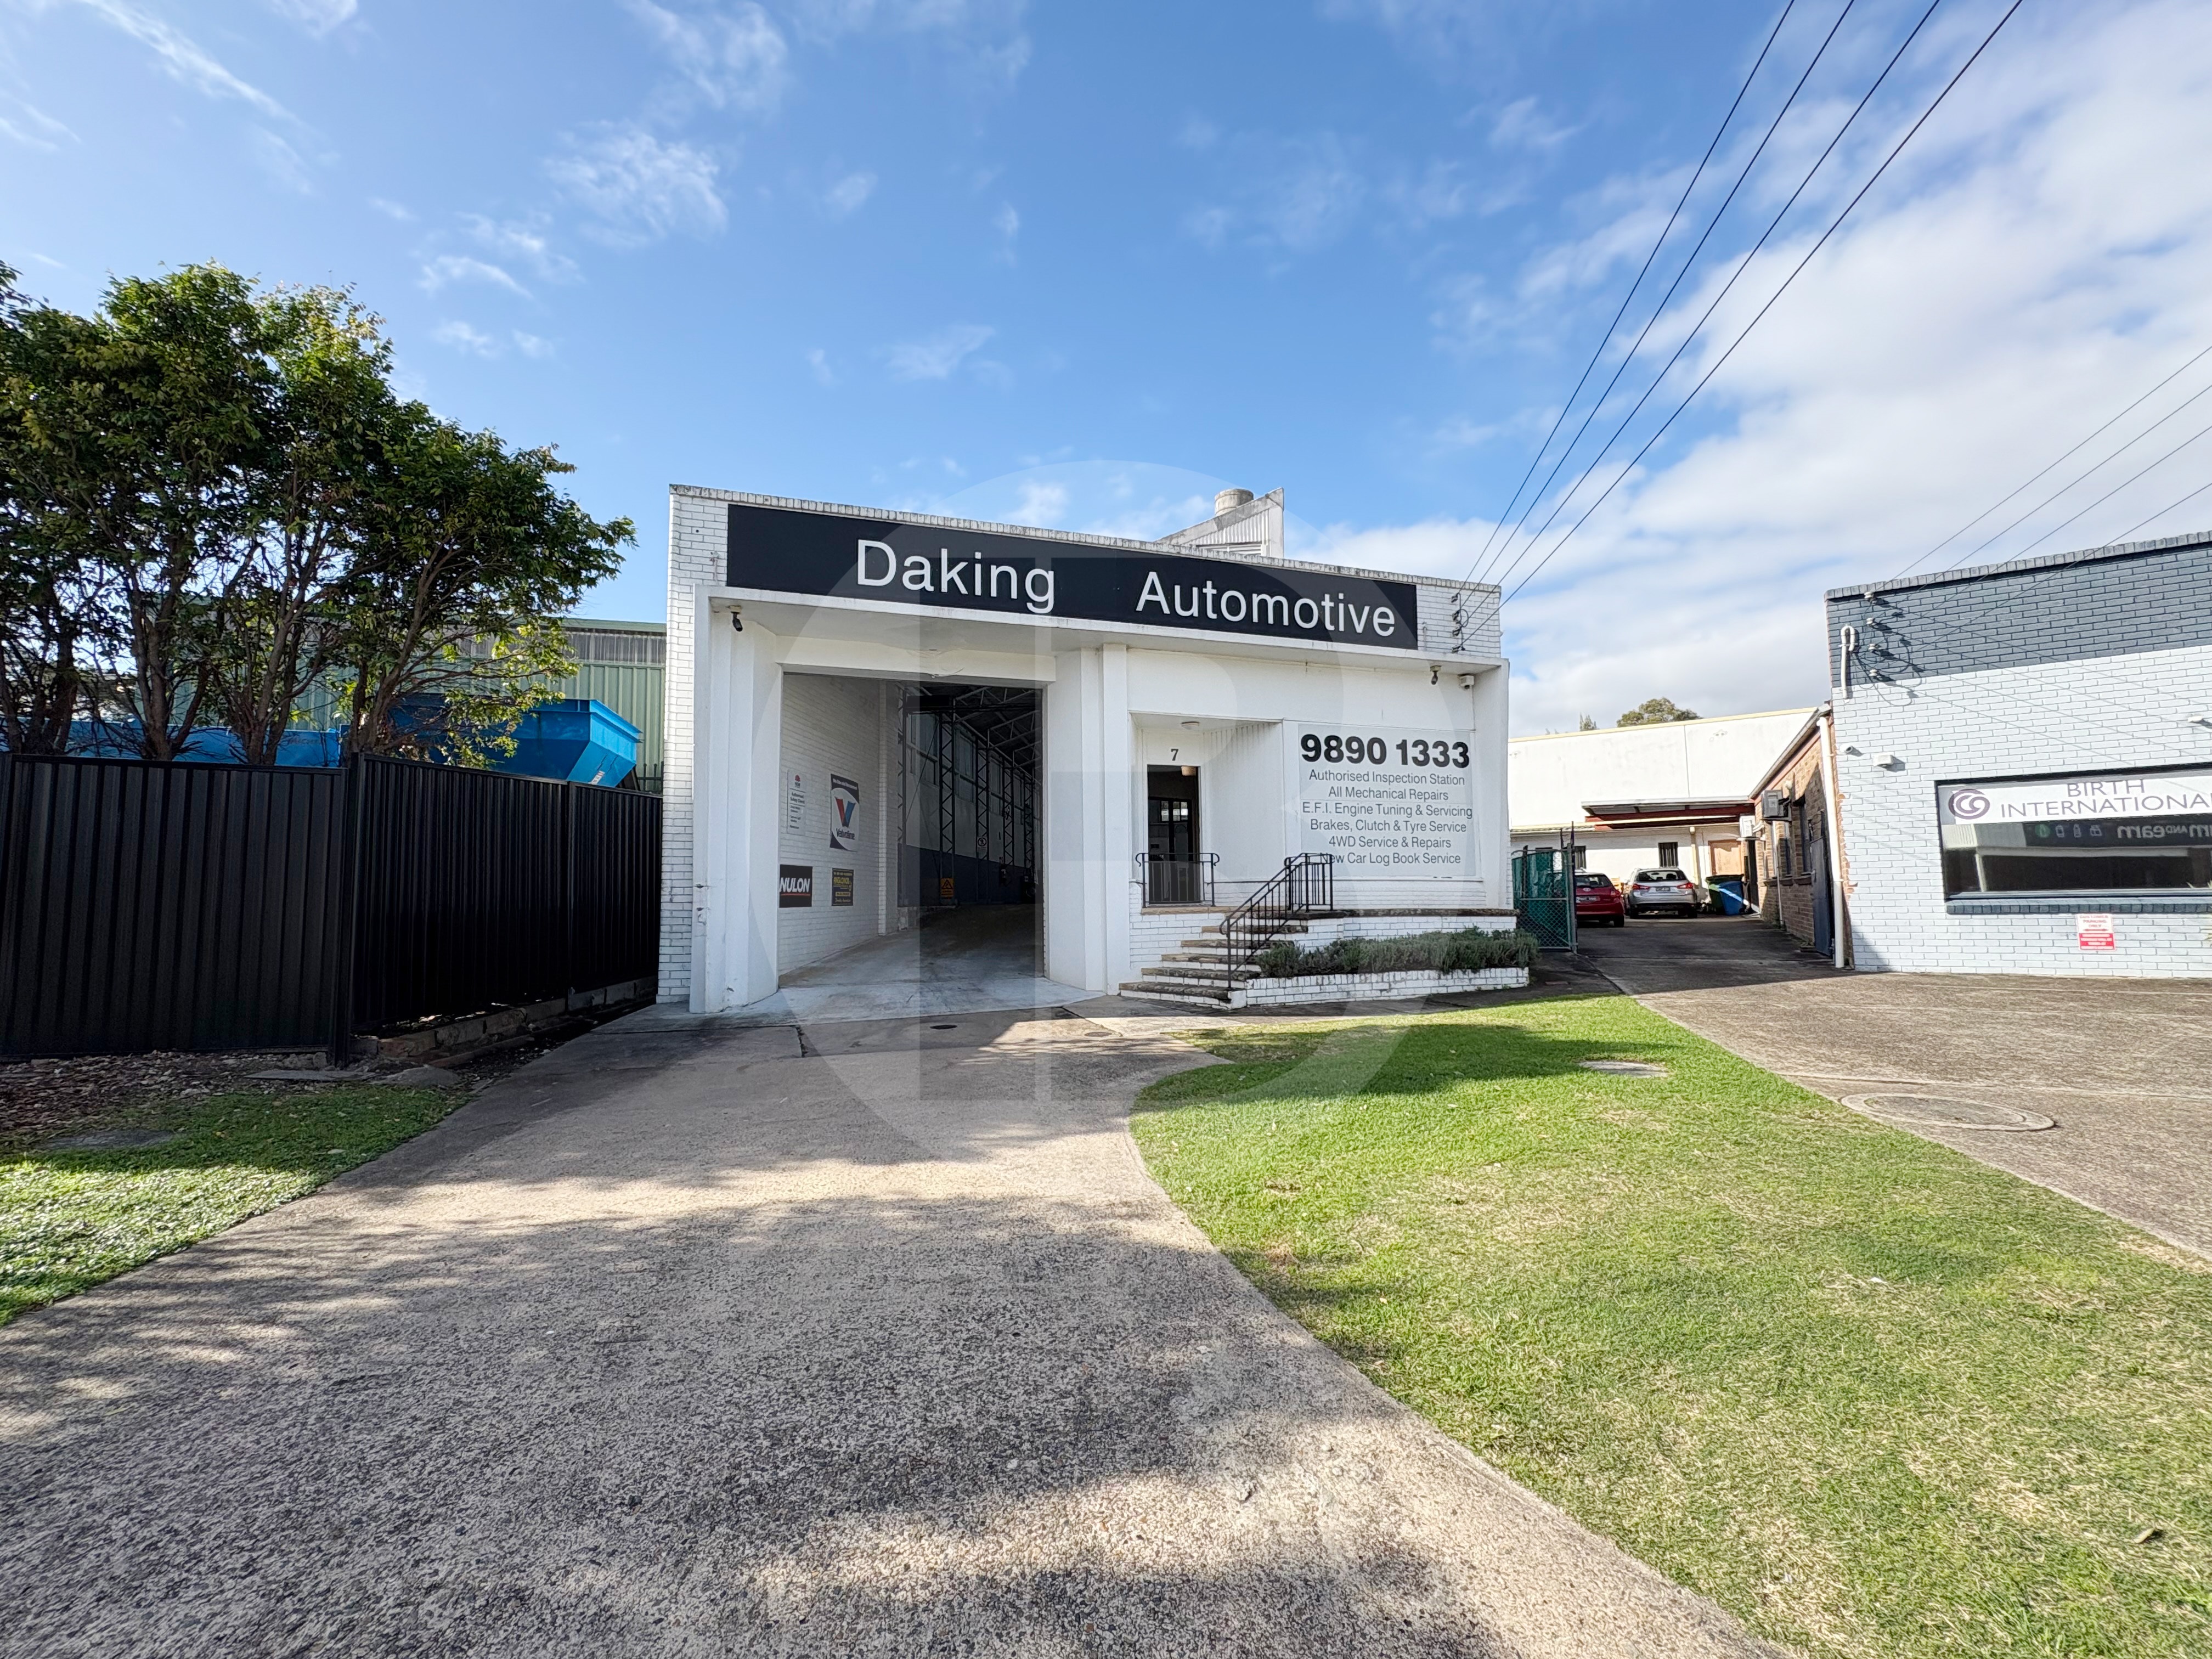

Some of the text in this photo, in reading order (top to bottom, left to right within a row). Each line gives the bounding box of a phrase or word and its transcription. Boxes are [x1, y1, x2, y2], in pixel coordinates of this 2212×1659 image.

[857, 539, 1395, 636] Daking Automotive
[1171, 749, 1179, 761] 7
[1301, 734, 1470, 768] 9890 1333
[1309, 769, 1465, 785] Authorised Inspection Station
[1328, 787, 1448, 802] All Mechanical Repairs
[2067, 780, 2145, 797] BIRTH
[1303, 802, 1472, 819] E.F.I. Engine Tuning & Servicing
[2001, 793, 2212, 817] INTERNATIONA
[1311, 820, 1466, 834] Brakes, Clutch & Tyre Service
[1329, 836, 1451, 850] 4WD Service & Repairs
[1348, 853, 1366, 864] Car
[1369, 853, 1390, 866] Log
[1393, 853, 1420, 864] Book
[1423, 853, 1460, 864] Service
[780, 877, 810, 892] NULON
